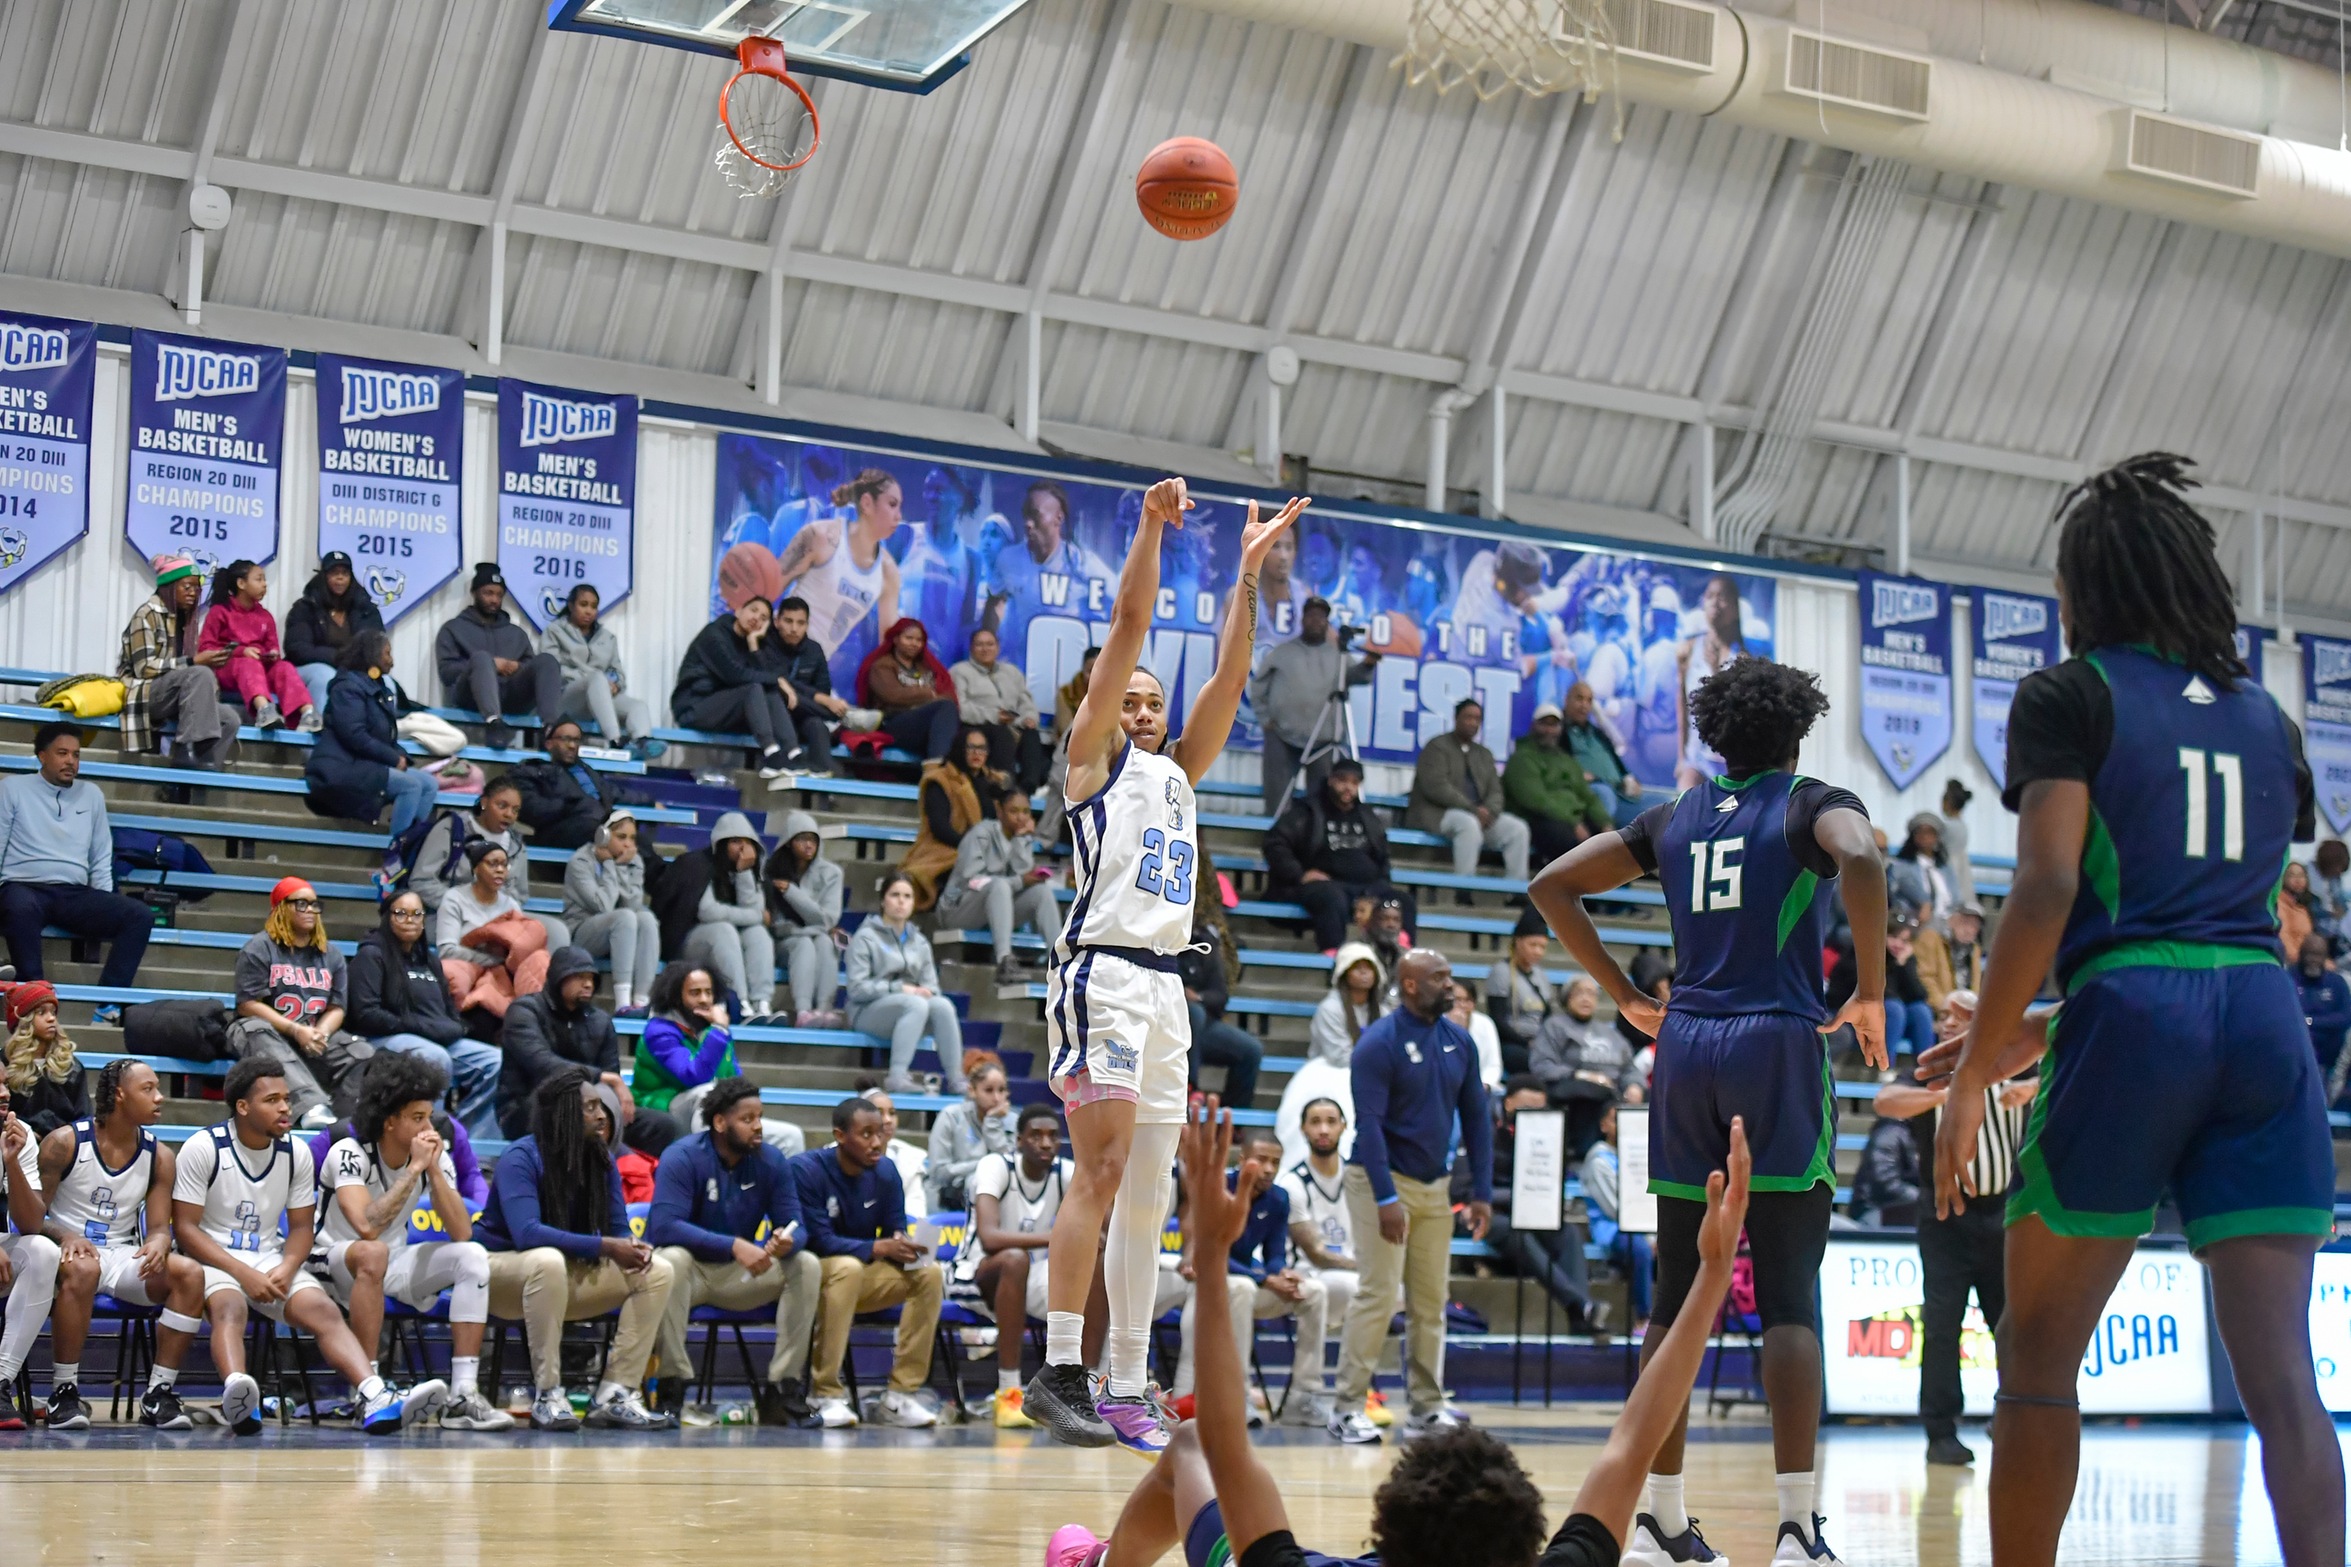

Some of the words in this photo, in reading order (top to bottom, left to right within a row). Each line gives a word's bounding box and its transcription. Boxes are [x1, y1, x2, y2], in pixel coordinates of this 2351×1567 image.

[160, 349, 257, 397] NJCAA
[0, 387, 47, 410] EN'S
[345, 372, 436, 418] NJCAA
[174, 408, 237, 436] MEN'S
[525, 397, 613, 441] NJCAA
[16, 447, 35, 462] 20
[42, 451, 65, 466] DIII
[138, 427, 268, 464] BASKETBALL
[343, 427, 435, 456] WOMEN'S
[147, 463, 201, 482] REGION
[208, 471, 227, 485] 20
[232, 472, 256, 490] DIII
[325, 449, 449, 481] BASKETBALL
[538, 453, 597, 479] MEN'S
[136, 484, 264, 518] CHAMPIONS
[333, 484, 357, 499] DIII
[363, 485, 426, 505] DISTRICT
[504, 472, 621, 505] BASKETBALL
[170, 515, 228, 540] 2015
[325, 504, 447, 534] CHAMPIONS
[513, 506, 562, 524] REGION
[569, 512, 585, 527] 20
[590, 516, 611, 530] DIII
[357, 534, 413, 557] 2015
[504, 526, 619, 557] CHAMPIONS
[533, 556, 585, 579] 2016
[1436, 621, 1516, 661] THE
[1862, 645, 1943, 674] BASKETBALL
[2179, 746, 2243, 862] 11
[1135, 827, 1194, 905] 23
[1690, 836, 1744, 912] 15
[228, 1229, 260, 1252] 11
[1848, 1320, 1912, 1357] MD
[2083, 1314, 2178, 1377] JCAA
